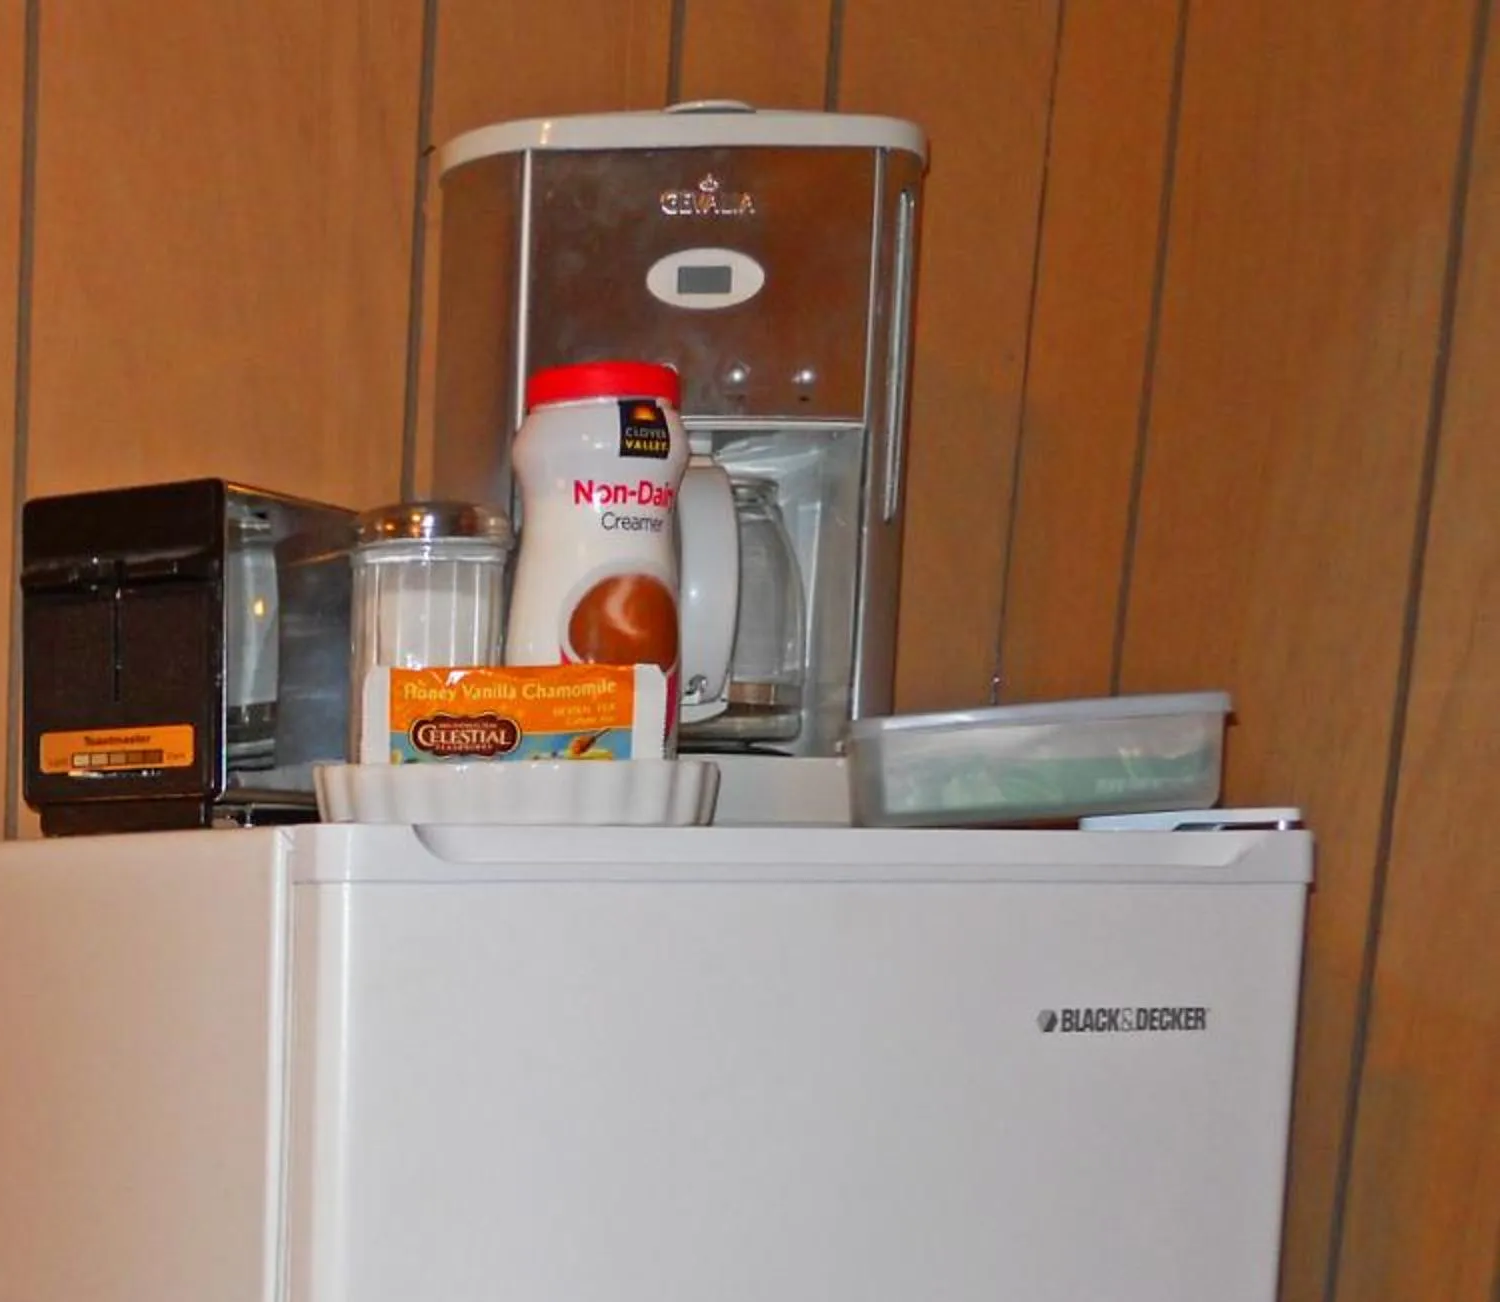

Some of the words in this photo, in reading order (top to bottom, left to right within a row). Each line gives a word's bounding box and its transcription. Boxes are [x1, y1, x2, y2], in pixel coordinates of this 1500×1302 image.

[462, 681, 518, 700] Vanilla
[522, 678, 617, 700] Chamomile
[417, 723, 512, 747] CELESTIAL
